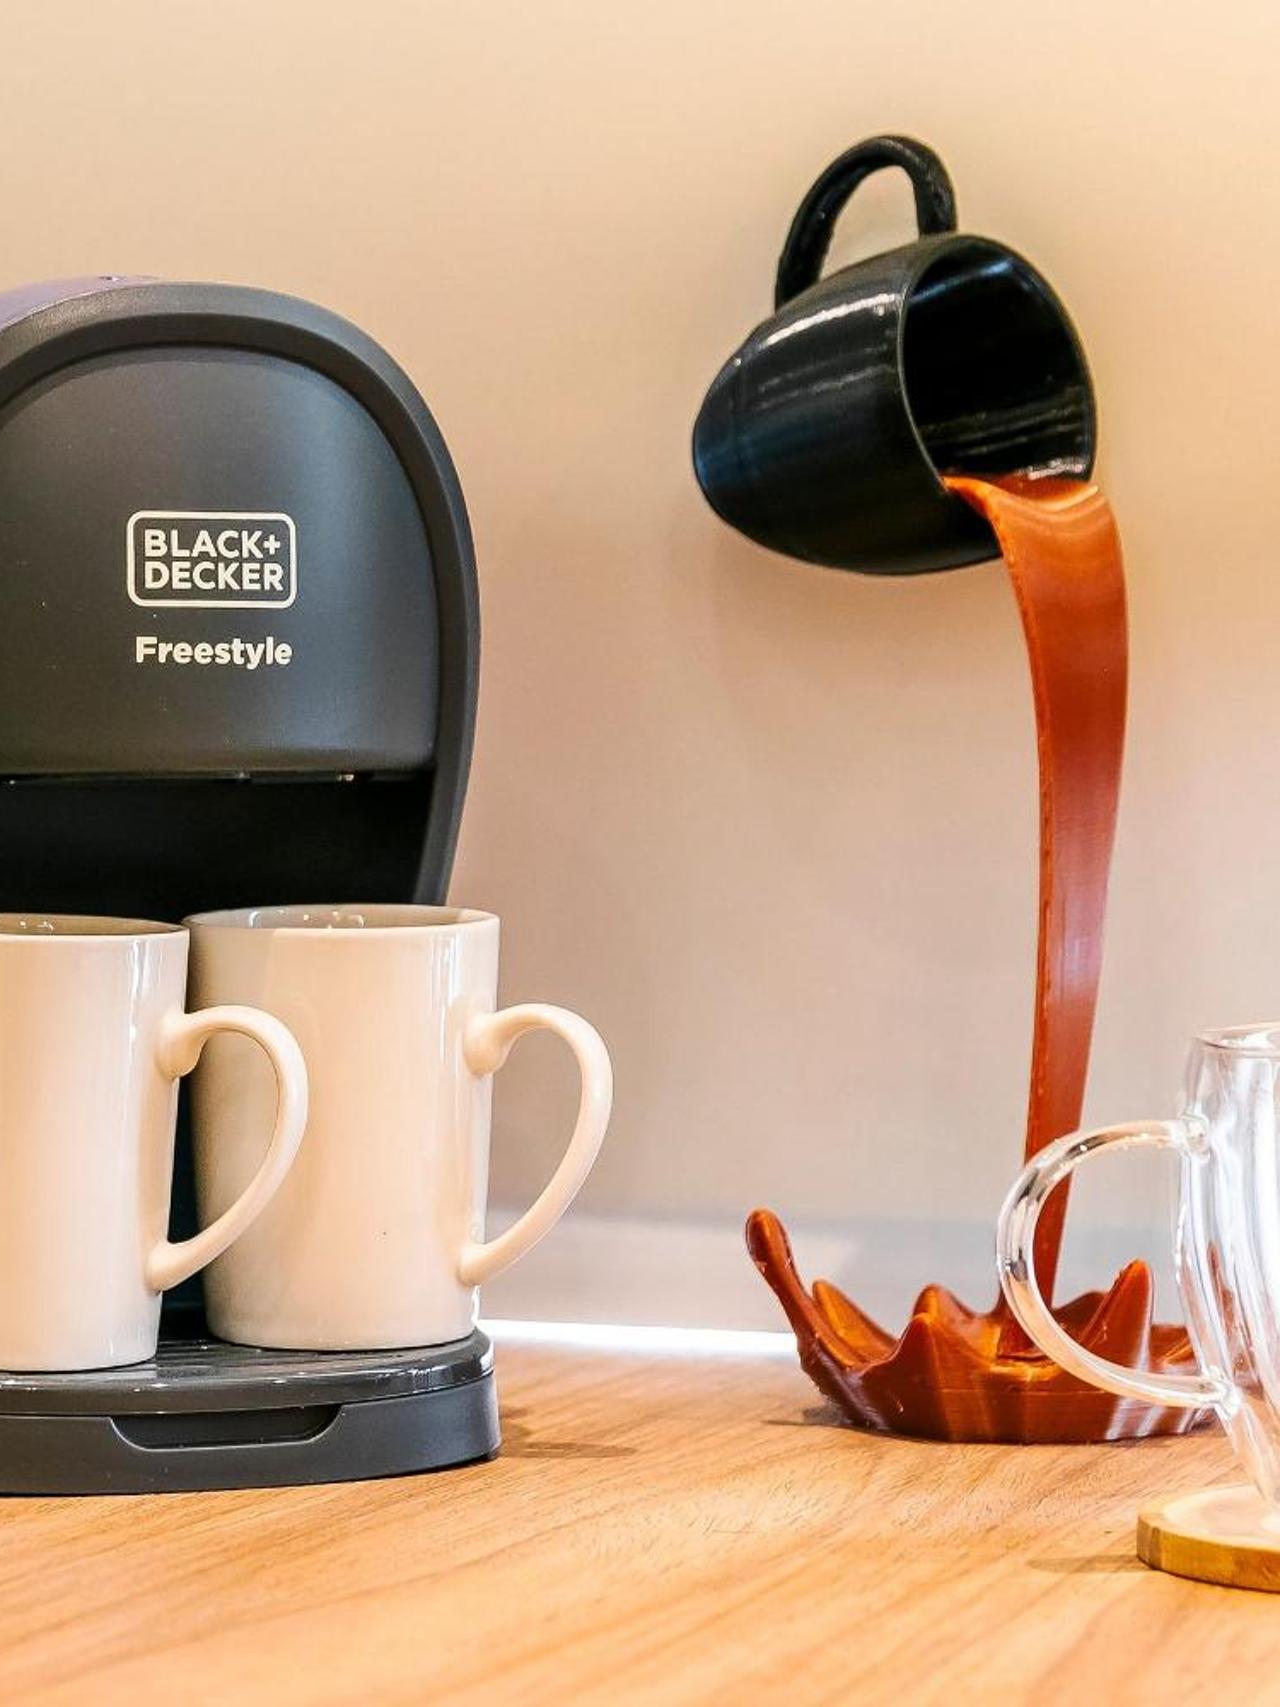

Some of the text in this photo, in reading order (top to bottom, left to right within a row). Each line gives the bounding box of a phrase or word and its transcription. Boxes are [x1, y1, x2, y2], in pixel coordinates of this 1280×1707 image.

[144, 529, 281, 559] BLACK+
[144, 561, 284, 591] DECKER
[136, 636, 293, 670] Freestyle
